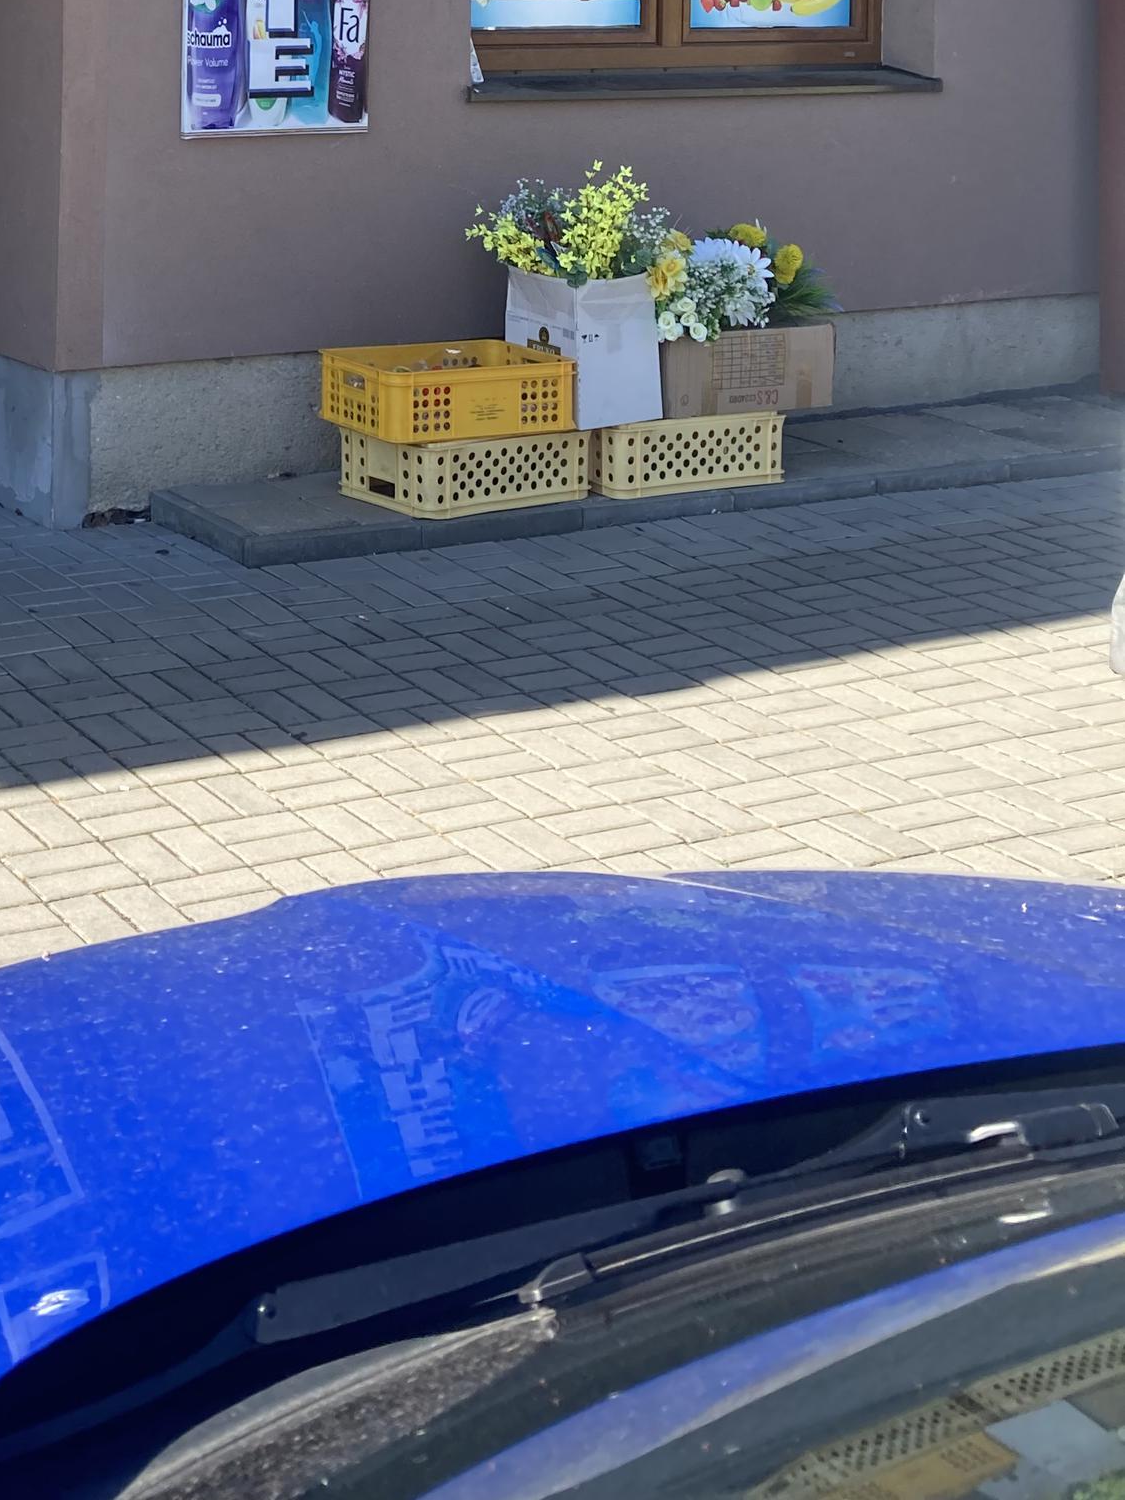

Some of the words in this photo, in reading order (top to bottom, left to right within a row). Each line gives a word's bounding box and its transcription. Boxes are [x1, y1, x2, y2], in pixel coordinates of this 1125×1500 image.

[338, 7, 360, 43] Fa
[187, 29, 231, 47] schauma
[205, 57, 229, 68] Volume
